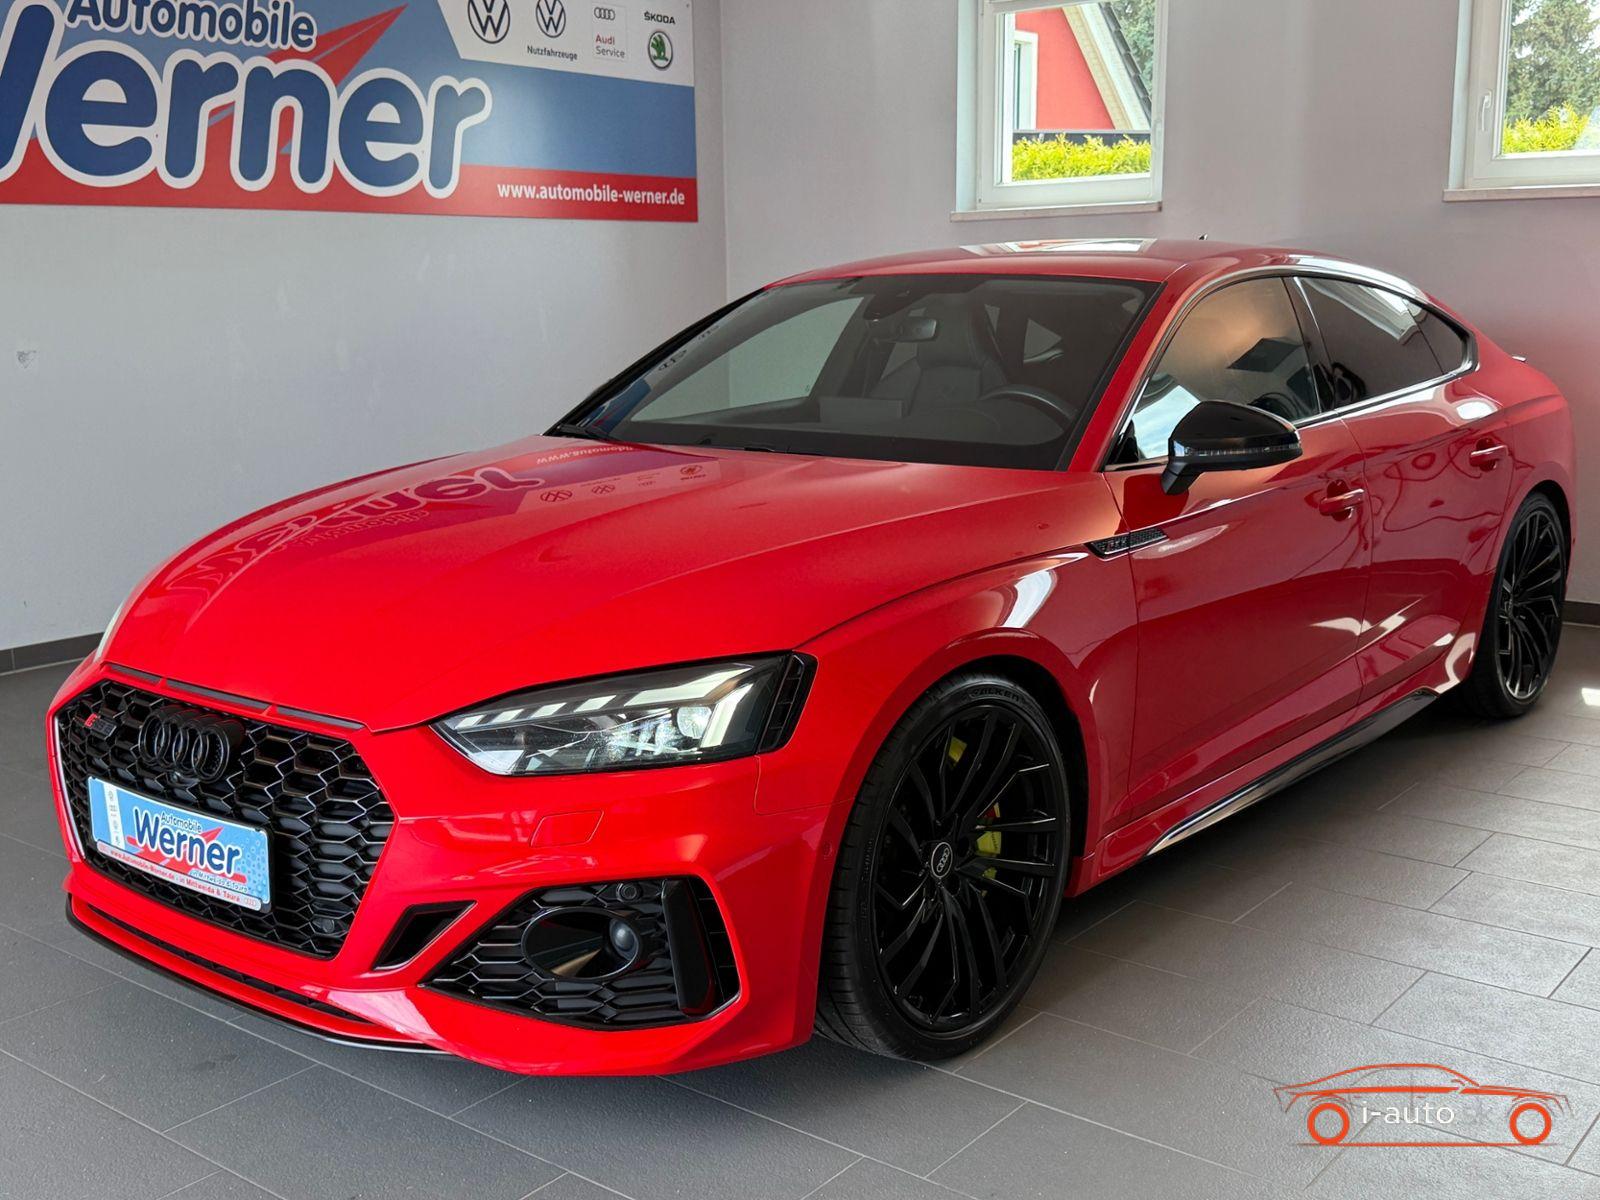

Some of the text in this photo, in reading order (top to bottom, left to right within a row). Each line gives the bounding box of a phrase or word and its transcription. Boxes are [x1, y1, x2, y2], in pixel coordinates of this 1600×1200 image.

[66, 0, 316, 49] Automobile
[643, 11, 676, 25] ŠKODA
[595, 34, 615, 45] Audi
[526, 45, 578, 61] Nutzfahrzeuge
[595, 46, 625, 59] Service
[497, 182, 685, 206] www.automobile-werner.de
[160, 811, 201, 834] Automobile
[133, 807, 241, 876] Werner
